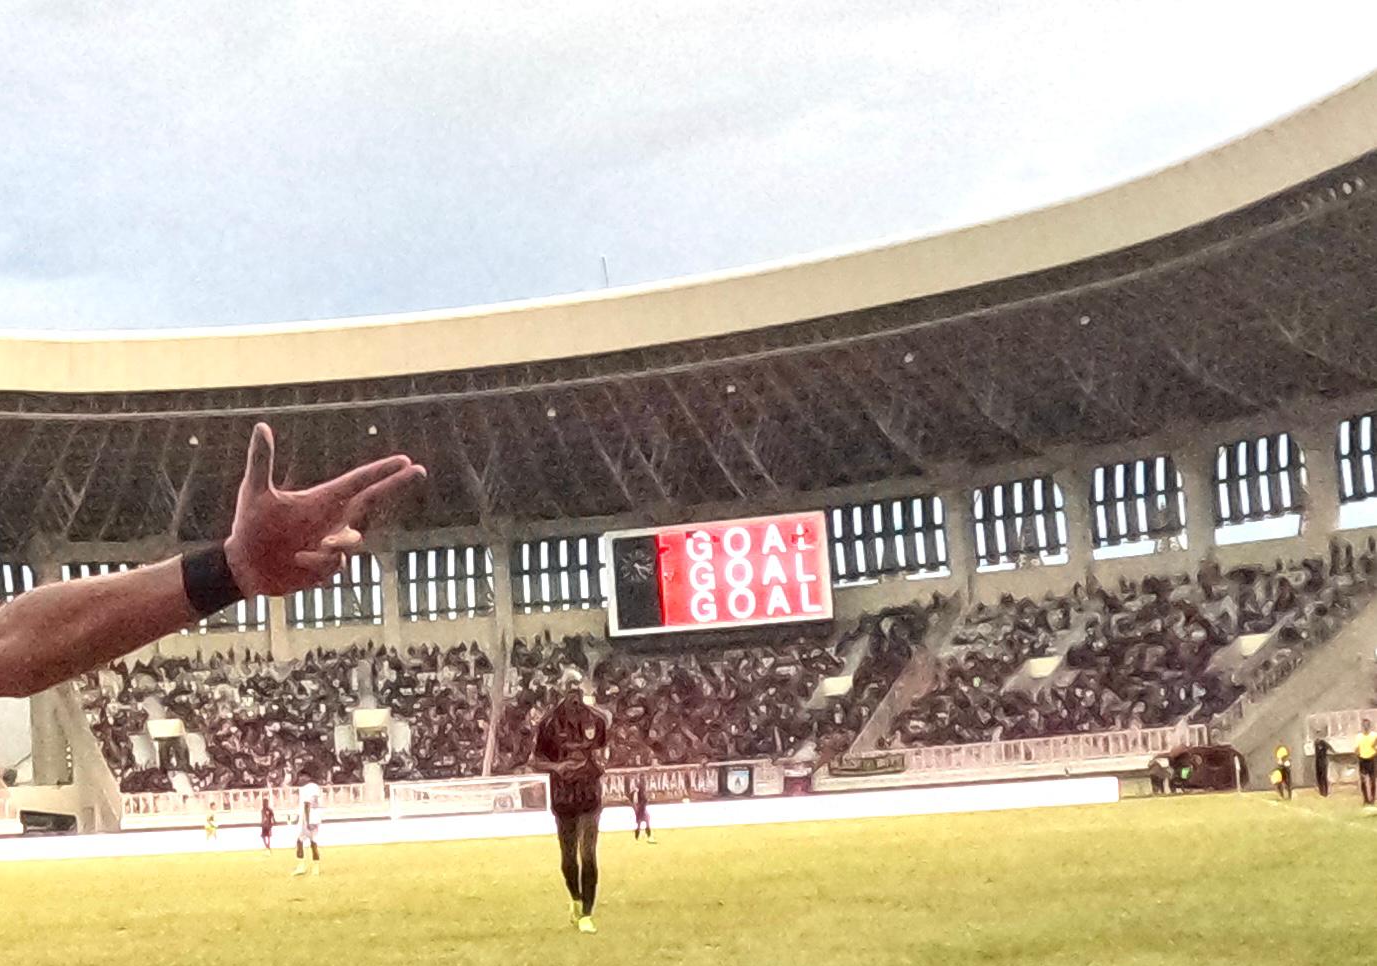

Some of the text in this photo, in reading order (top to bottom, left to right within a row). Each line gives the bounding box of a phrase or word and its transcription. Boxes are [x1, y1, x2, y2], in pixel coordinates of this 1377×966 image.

[686, 523, 815, 562] GOAL
[689, 552, 817, 592] GOAL
[690, 583, 823, 623] GOAL
